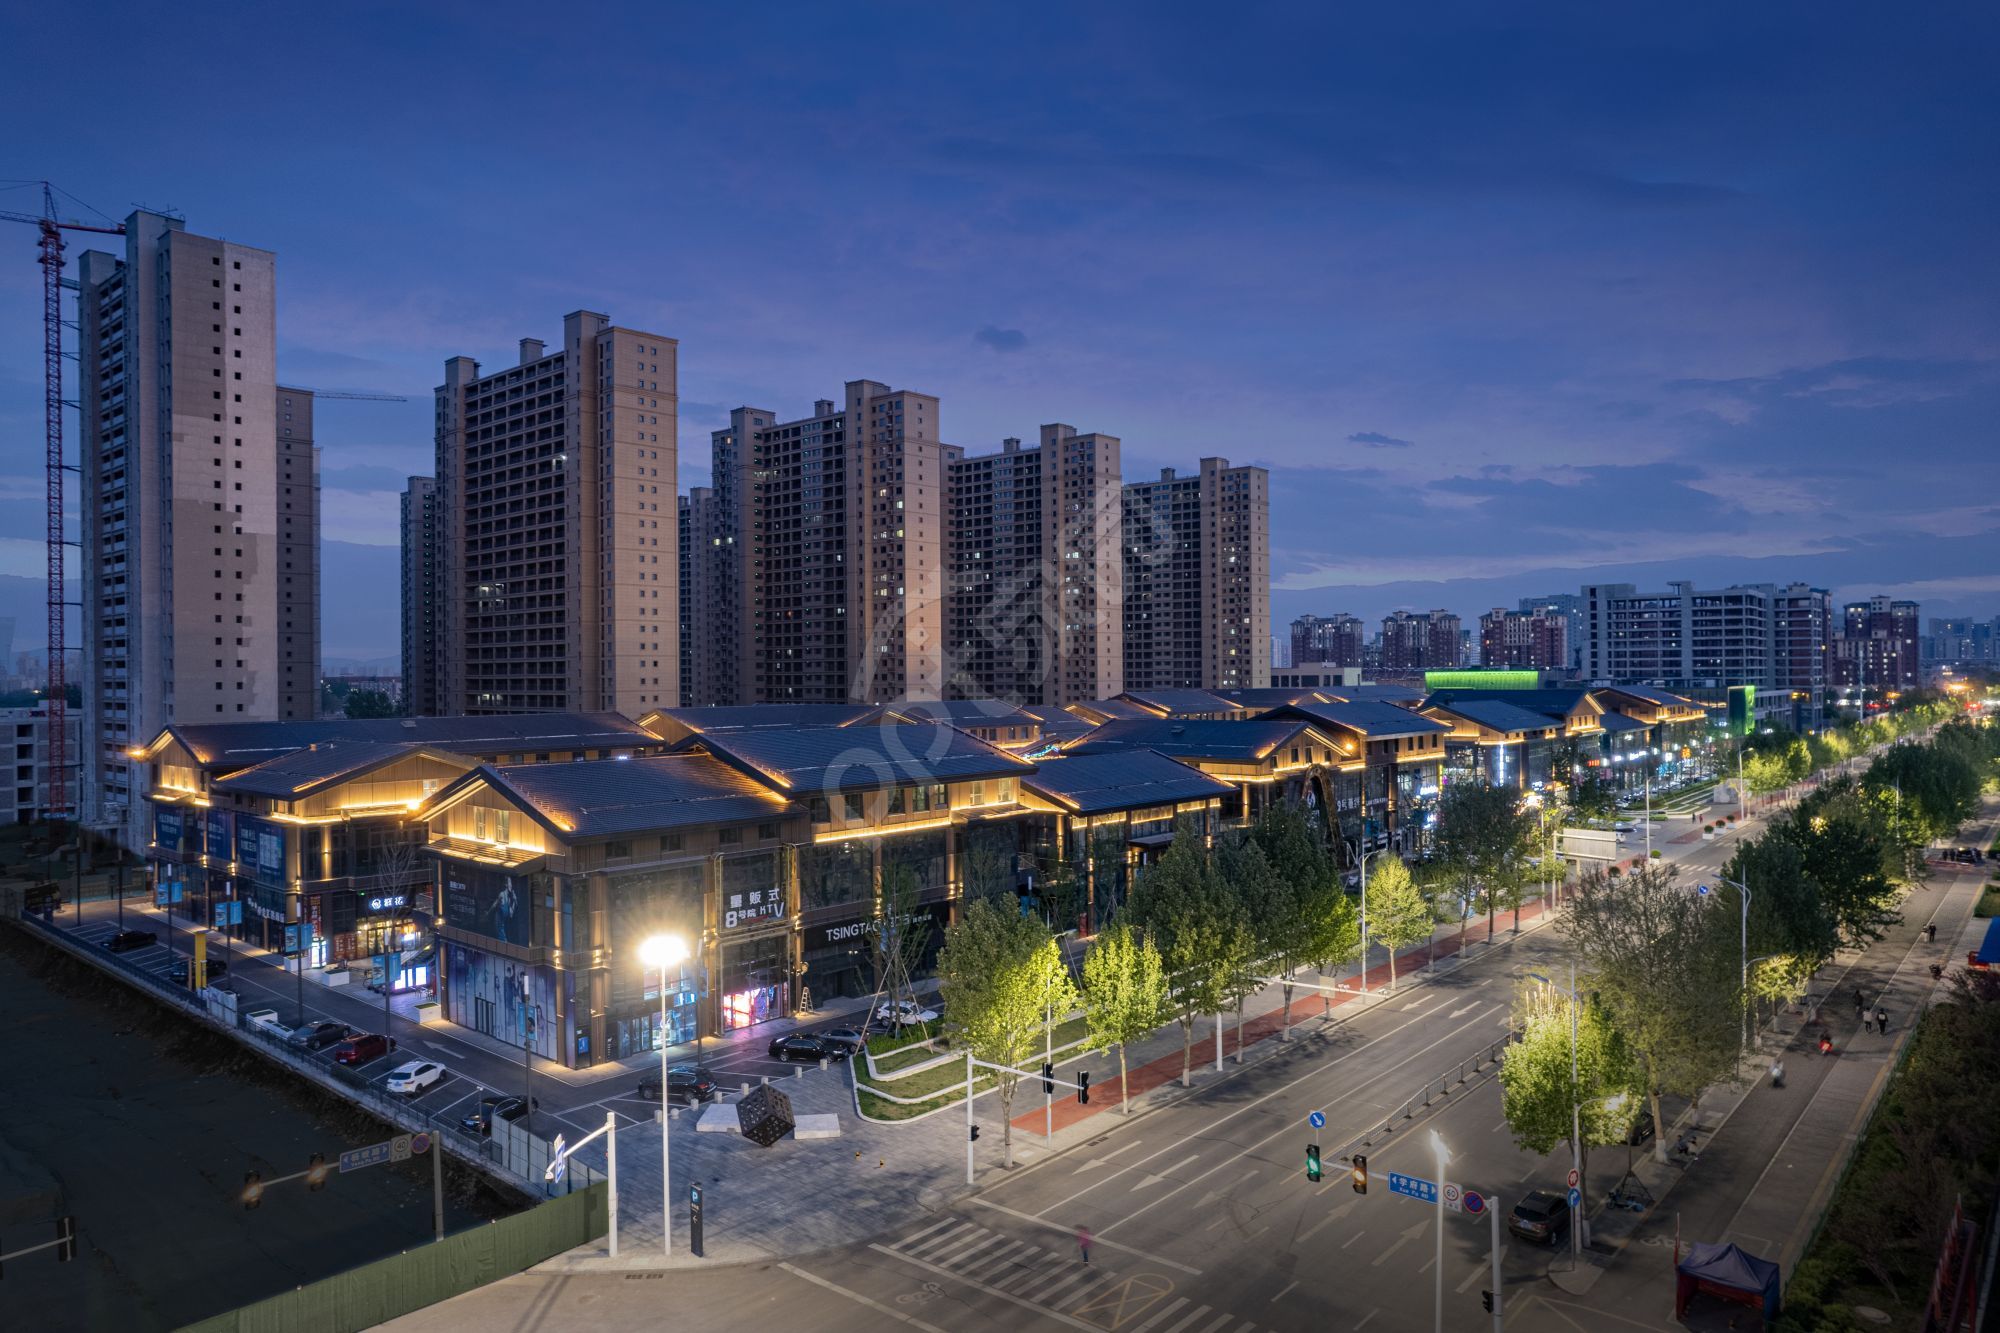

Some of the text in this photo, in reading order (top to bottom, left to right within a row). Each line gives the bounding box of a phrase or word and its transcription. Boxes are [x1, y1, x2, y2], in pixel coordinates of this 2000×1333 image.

[725, 902, 784, 928] 8号院 KTV
[1399, 1177, 1429, 1194] 学府路
[692, 1191, 698, 1202] P
[1446, 1189, 1456, 1198] 60
